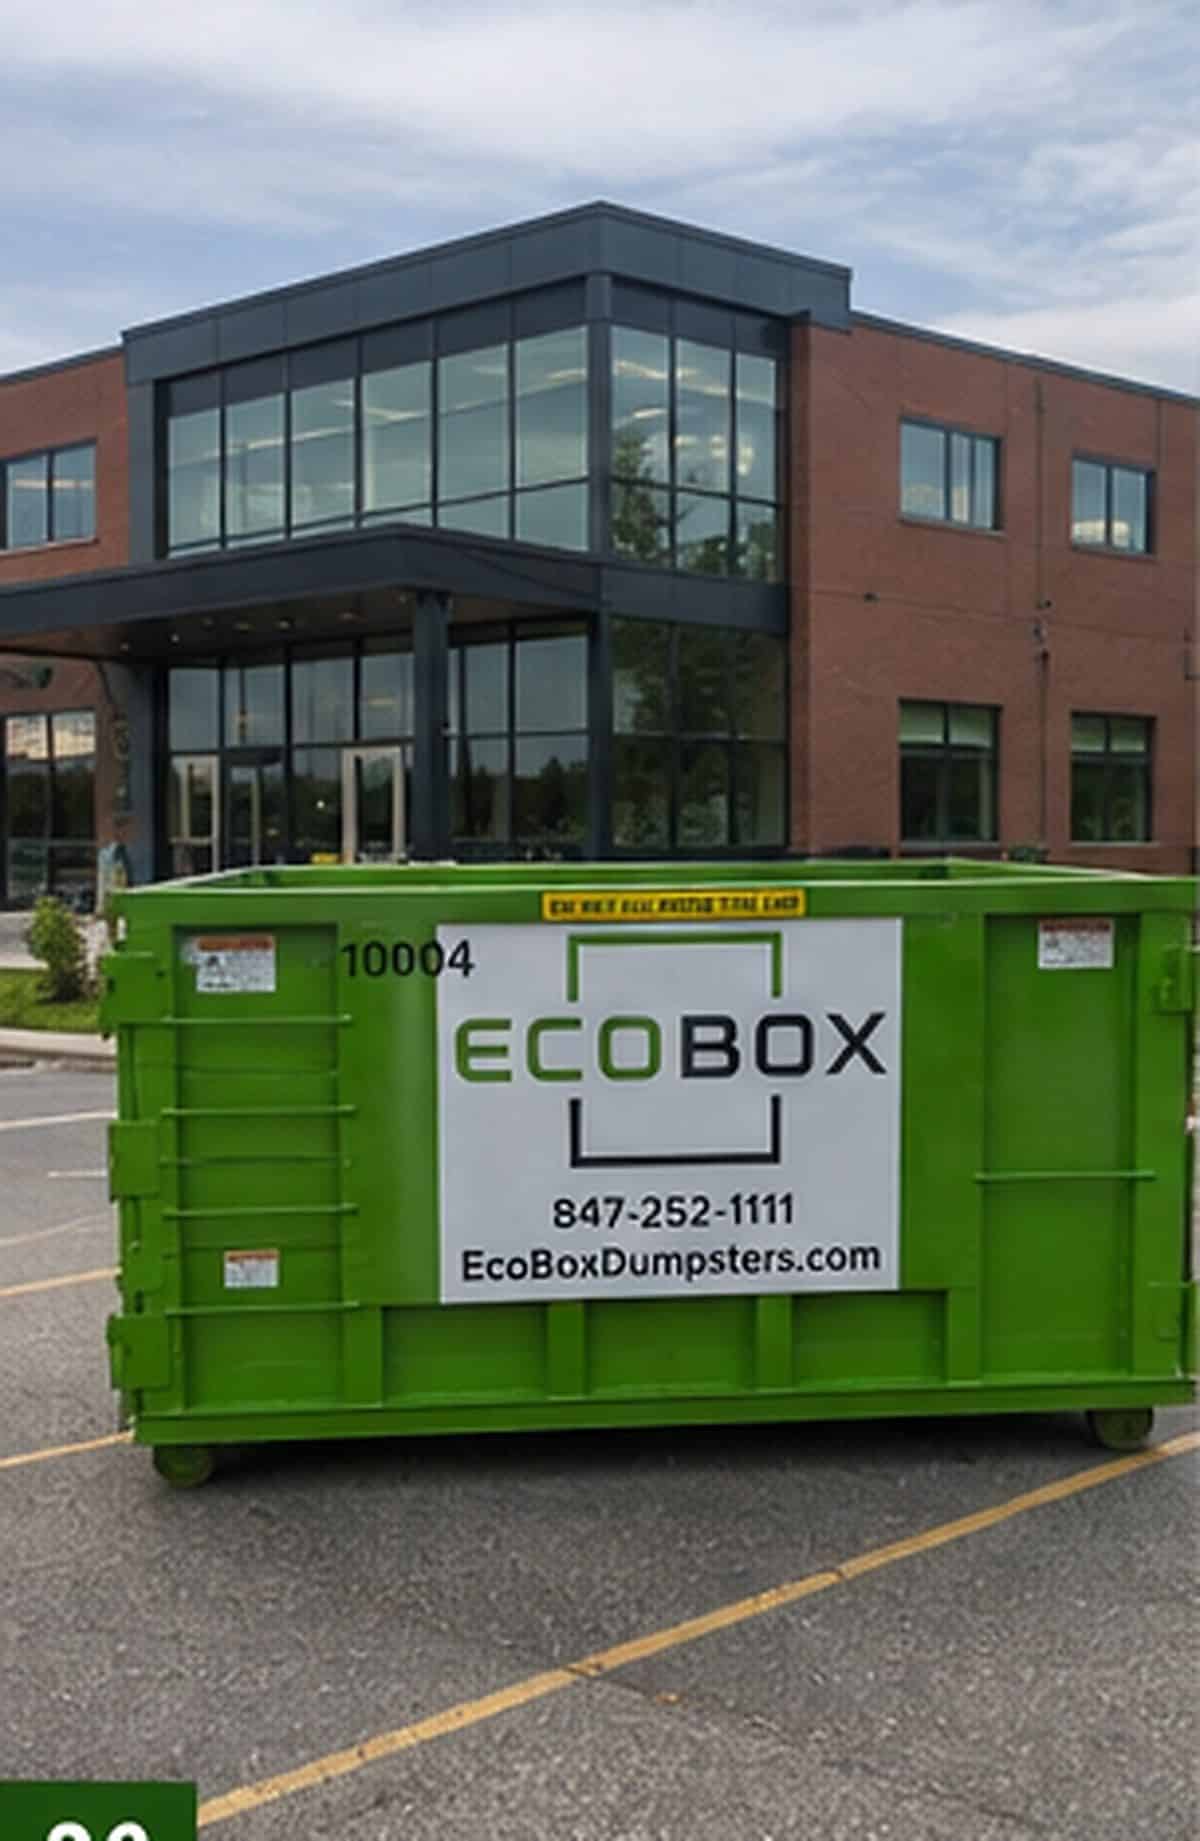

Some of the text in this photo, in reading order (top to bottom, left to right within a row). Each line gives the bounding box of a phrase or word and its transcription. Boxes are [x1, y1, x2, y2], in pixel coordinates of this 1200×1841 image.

[341, 939, 475, 978] 10004
[454, 1011, 887, 1082] ECOBOX
[553, 1192, 795, 1229] 847-252-1111
[461, 1244, 881, 1282] EcoBoxDumpsters.com
